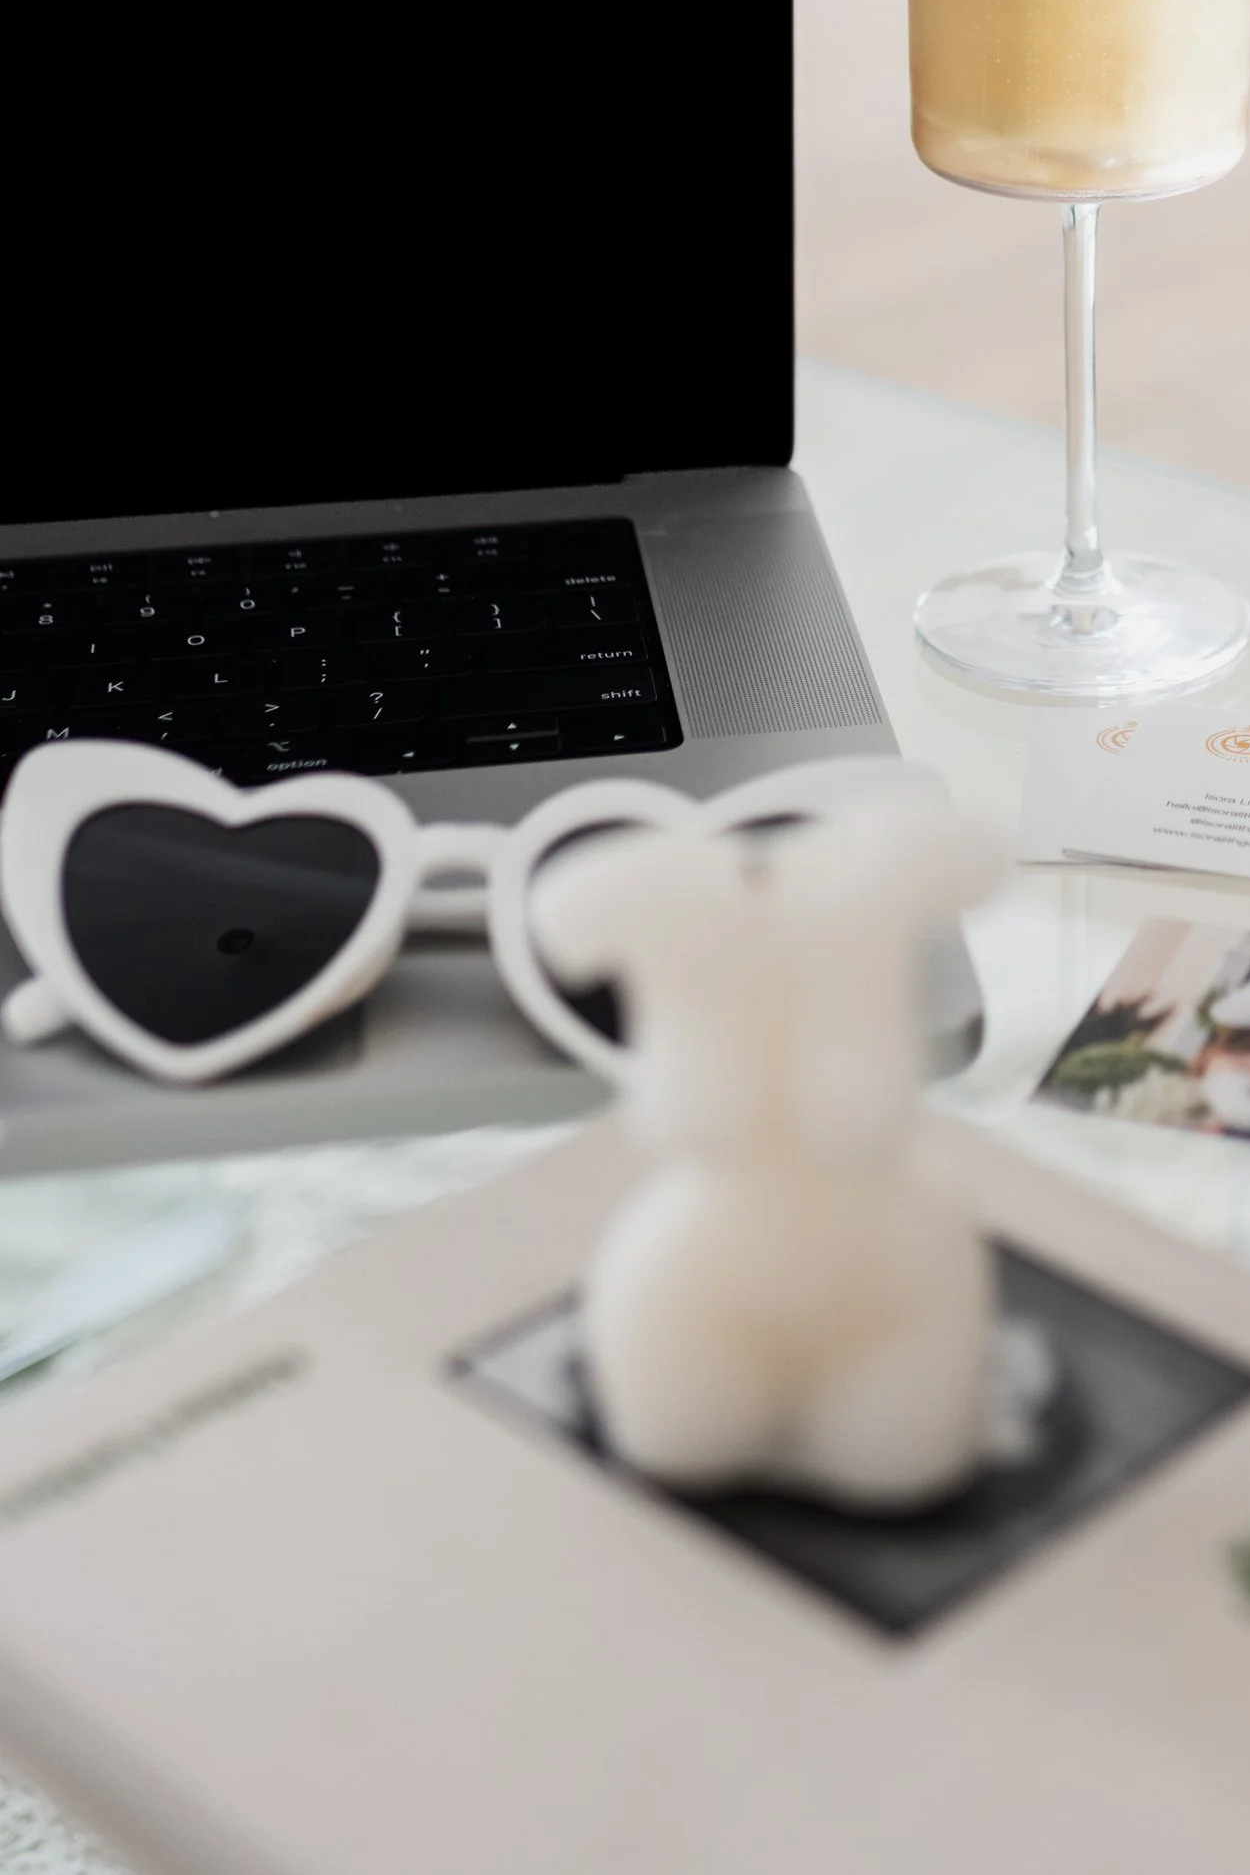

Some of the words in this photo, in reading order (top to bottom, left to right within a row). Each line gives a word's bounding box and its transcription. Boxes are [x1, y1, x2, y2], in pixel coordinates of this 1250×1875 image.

[565, 575, 617, 586] delete
[239, 599, 256, 610] 0
[139, 606, 156, 618] 9
[38, 614, 54, 625] 8
[290, 627, 306, 638] P
[186, 635, 205, 646] O
[580, 650, 633, 660] return
[214, 673, 228, 684] L
[107, 681, 124, 693] K
[1, 689, 17, 701] J
[600, 689, 641, 700] shift
[46, 727, 70, 740] M
[266, 759, 327, 772] option
[1204, 792, 1237, 805] Isora
